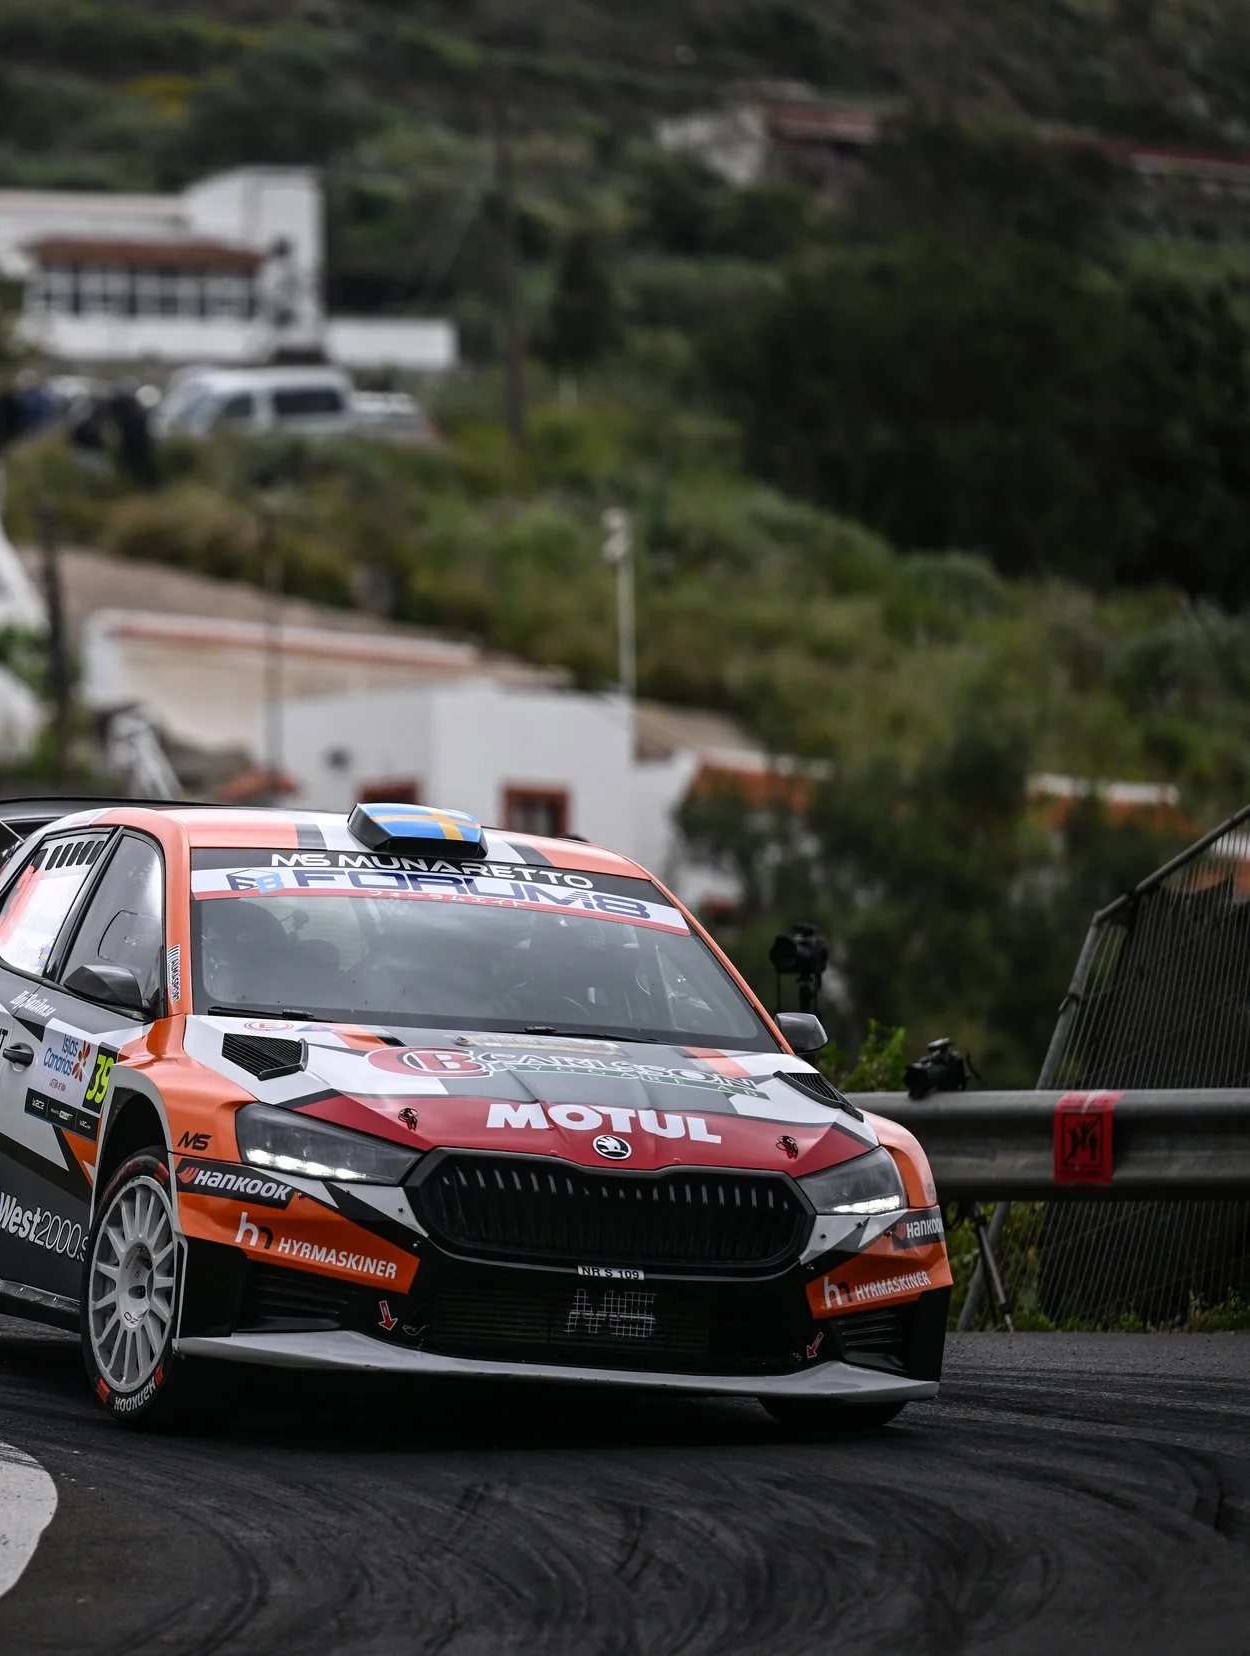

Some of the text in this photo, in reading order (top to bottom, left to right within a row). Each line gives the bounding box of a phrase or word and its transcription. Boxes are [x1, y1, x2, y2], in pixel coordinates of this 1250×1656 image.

[271, 854, 594, 889] MS MUNARETTO
[292, 869, 651, 919] FORUM8
[43, 1047, 74, 1076] Canarias
[62, 1034, 79, 1058] Islas
[86, 1054, 115, 1104] 39
[486, 1103, 722, 1144] MOTUL
[177, 1130, 213, 1151] MS
[278, 1237, 398, 1280] HYRMASKINER
[582, 1266, 640, 1280] NR S 109
[854, 1270, 932, 1301] HYRMASKINER
[123, 1311, 140, 1325] OZ
